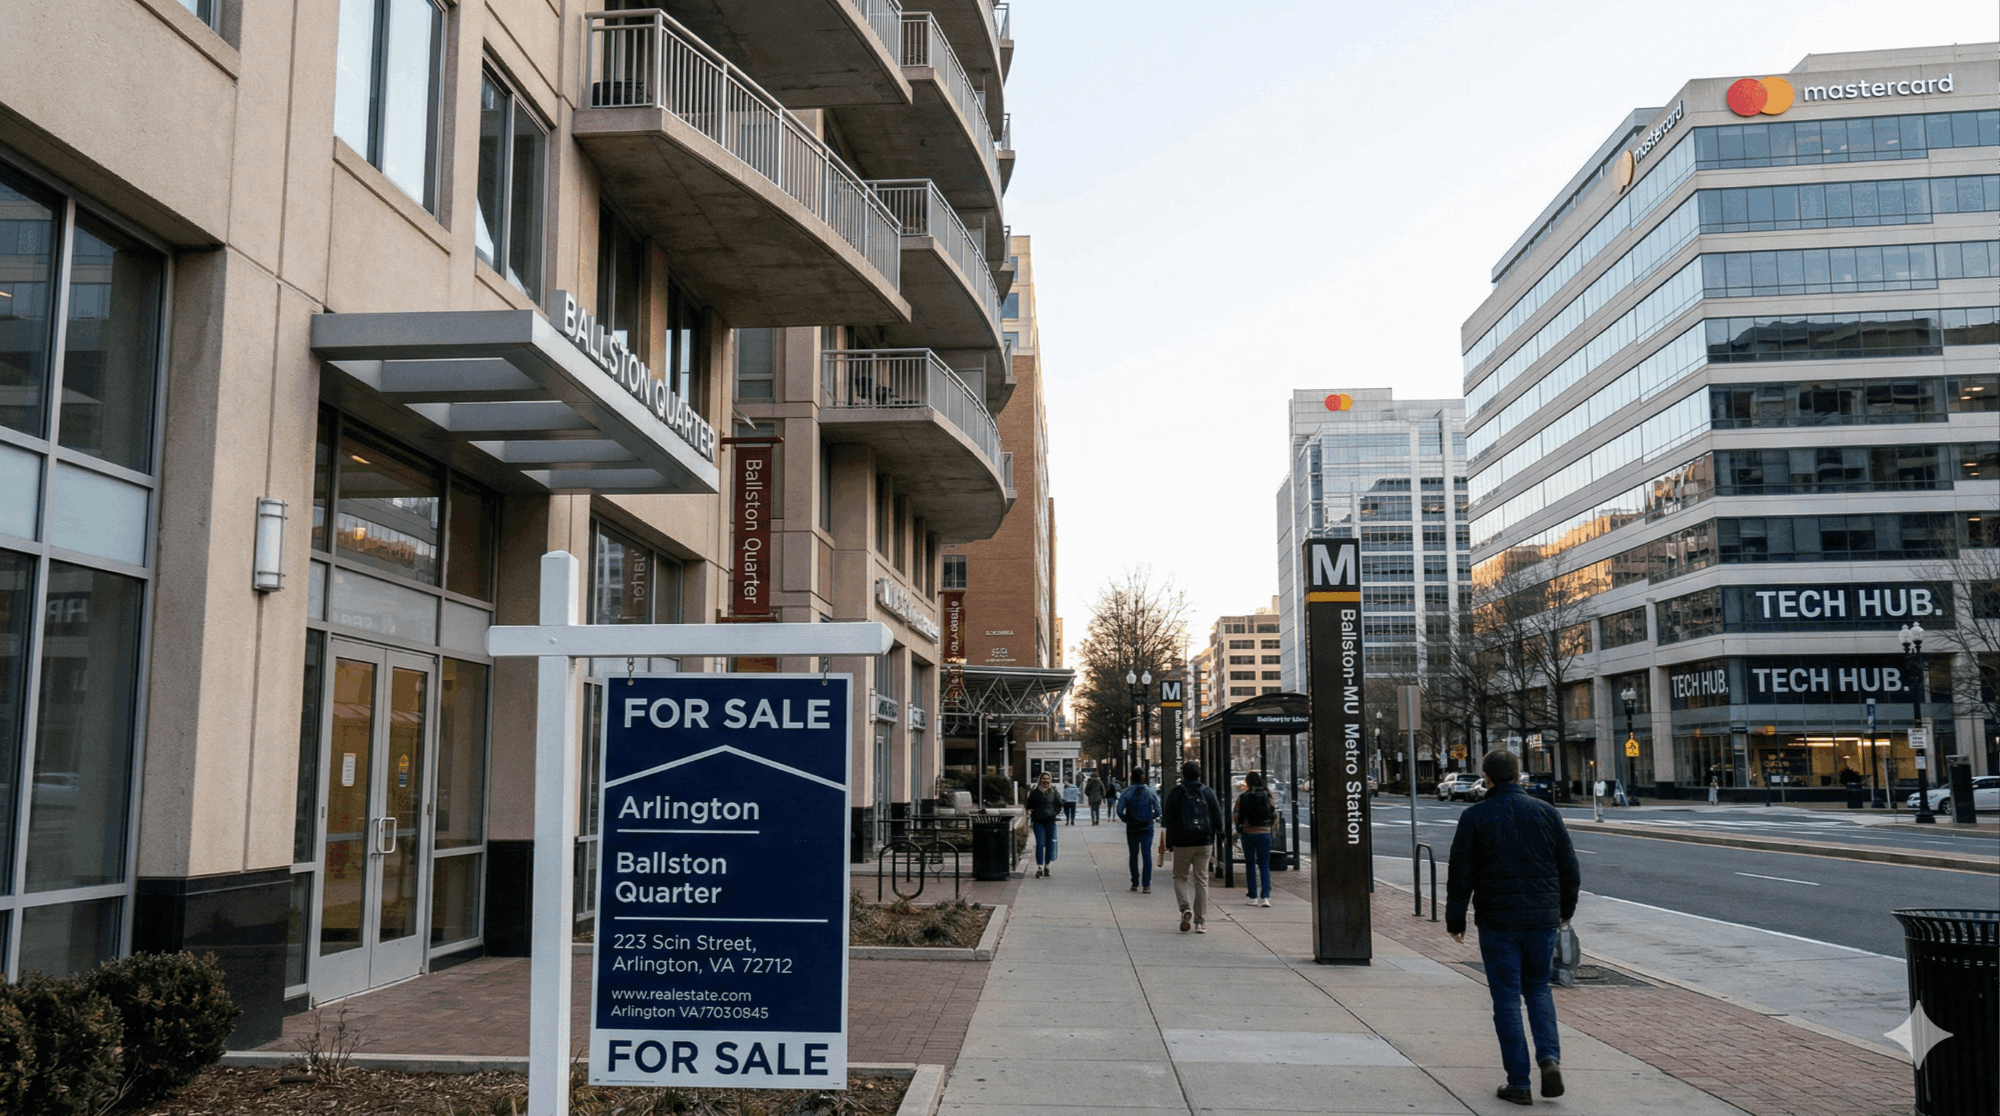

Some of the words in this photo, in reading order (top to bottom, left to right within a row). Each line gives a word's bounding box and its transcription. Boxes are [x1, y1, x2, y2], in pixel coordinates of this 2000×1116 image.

[1803, 73, 1955, 102] mastercard
[1633, 100, 1684, 166] mastercard
[564, 290, 652, 406] BALLSTON
[655, 378, 716, 463] QUARTER
[744, 459, 763, 531] Ballston
[743, 537, 762, 604] Quarter
[1312, 544, 1356, 586] M
[1755, 589, 1846, 619] TECH
[1858, 588, 1943, 617] HUB.
[1341, 609, 1360, 715] Ballston-MU
[1162, 682, 1181, 700] M
[1671, 673, 1700, 699] TECH
[1702, 669, 1729, 694] HUB.
[1752, 668, 1830, 693] TECH
[1838, 667, 1910, 692] HUB.
[624, 697, 710, 729] FOR
[723, 698, 831, 729] SALE
[1344, 723, 1361, 775] Metro
[618, 795, 760, 824] Arlington
[1346, 781, 1363, 845] Station
[616, 851, 727, 875] Ballston
[615, 880, 722, 905] Quarter
[613, 933, 647, 950] 223
[652, 934, 691, 950] Scin
[696, 934, 757, 953] Street,
[612, 955, 703, 975] Arlington,
[709, 957, 735, 973] VA
[742, 957, 793, 974] 72712
[611, 987, 752, 1002] www.realestate.com
[610, 1004, 676, 1020] Arlington
[608, 1039, 699, 1074] FOR
[714, 1041, 829, 1076] SALE
